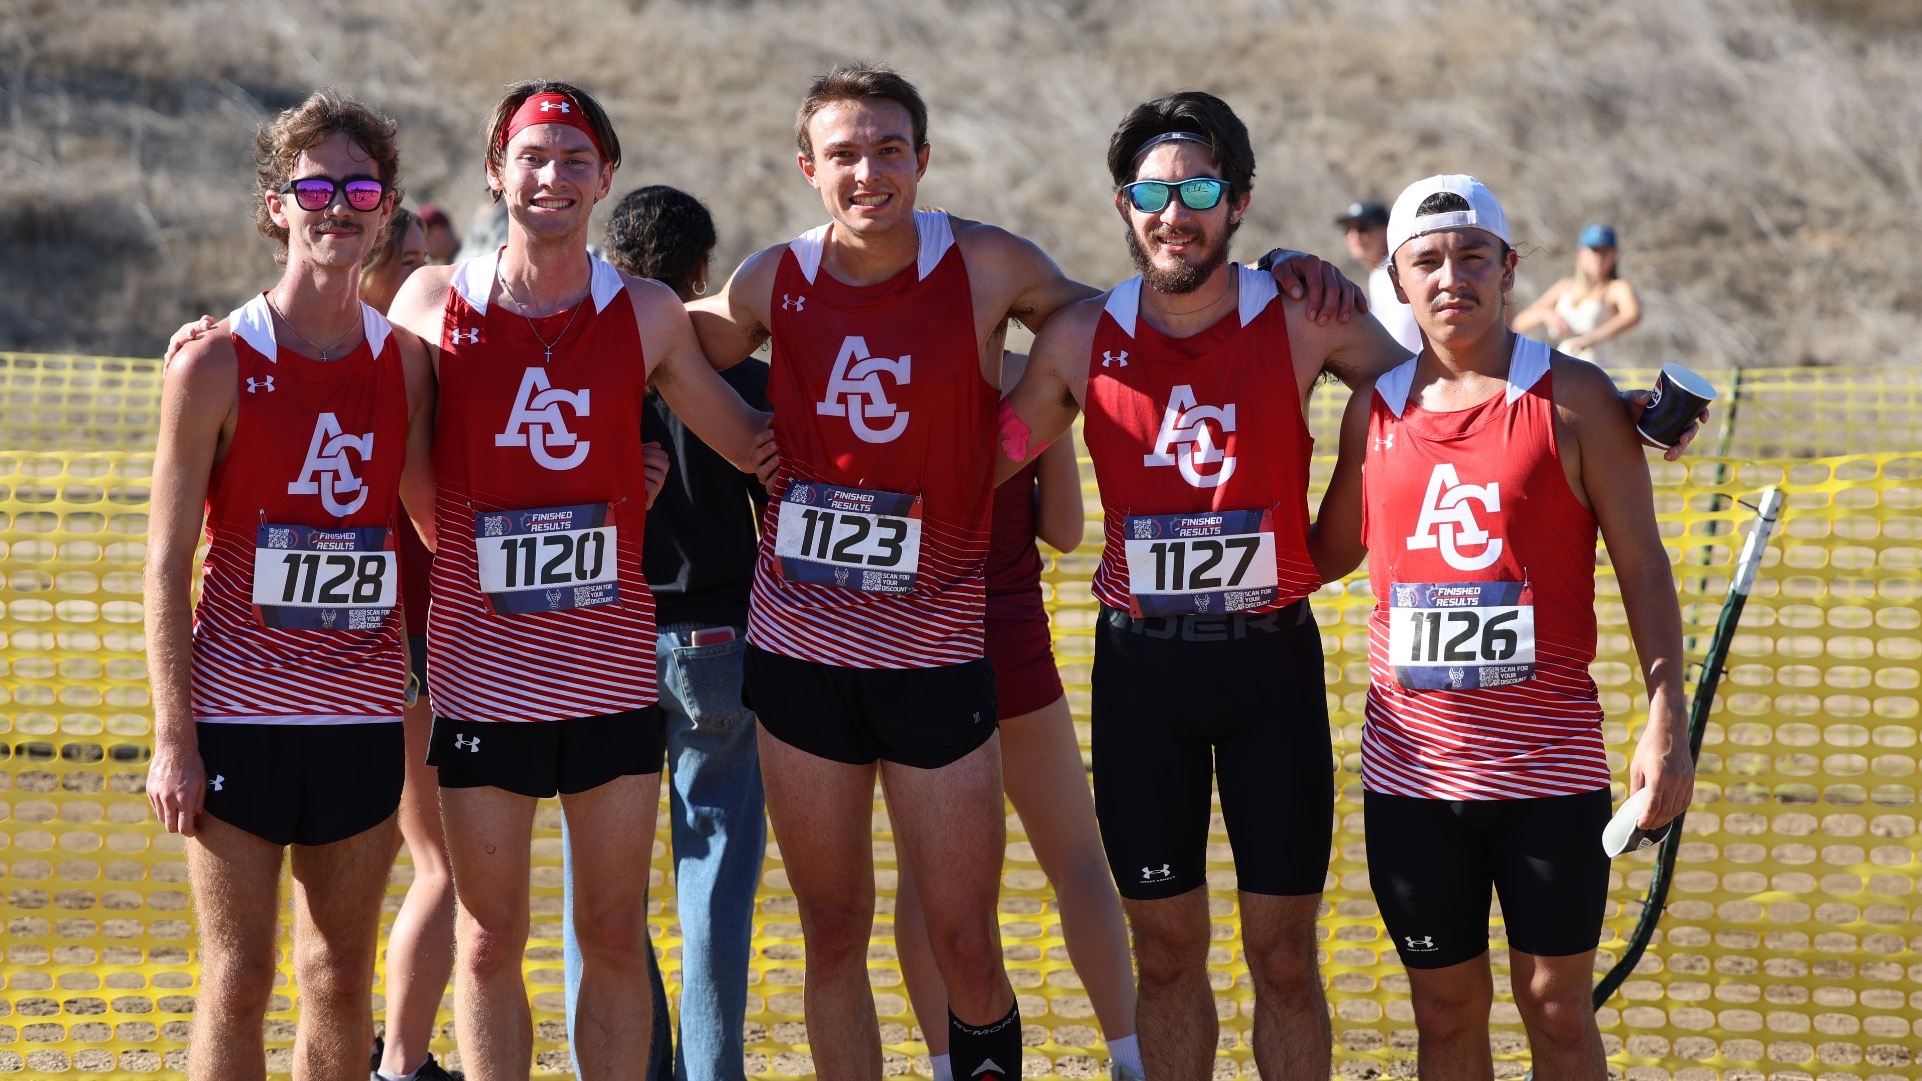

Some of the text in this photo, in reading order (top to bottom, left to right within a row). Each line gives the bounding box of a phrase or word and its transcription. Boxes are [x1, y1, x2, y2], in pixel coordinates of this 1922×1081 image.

[817, 336, 911, 443] AC
[495, 367, 590, 470] AC
[1144, 384, 1236, 488] AC
[288, 413, 373, 517] AC
[834, 491, 874, 502] FINISHED
[831, 501, 872, 512] RESULTS
[532, 511, 572, 522] FINISHED
[1182, 516, 1222, 526] FINISHED
[1406, 463, 1503, 571] AC
[531, 521, 572, 532] RESULTS
[1180, 526, 1221, 537] RESULTS
[320, 532, 356, 540] FINISHED
[801, 509, 908, 566] 1123
[316, 542, 354, 550] RESULTS
[500, 531, 605, 588] 1120
[1150, 536, 1260, 590] 1127
[282, 554, 386, 604] 1128
[590, 584, 602, 592] SCAN
[1438, 587, 1481, 596] FINISHED
[590, 596, 614, 605] DISCOUNT
[1244, 600, 1270, 608] DISCOUNT
[1436, 597, 1479, 606] RESULTS
[1410, 610, 1519, 662] 1126
[1500, 677, 1527, 685] DISCOUNT
